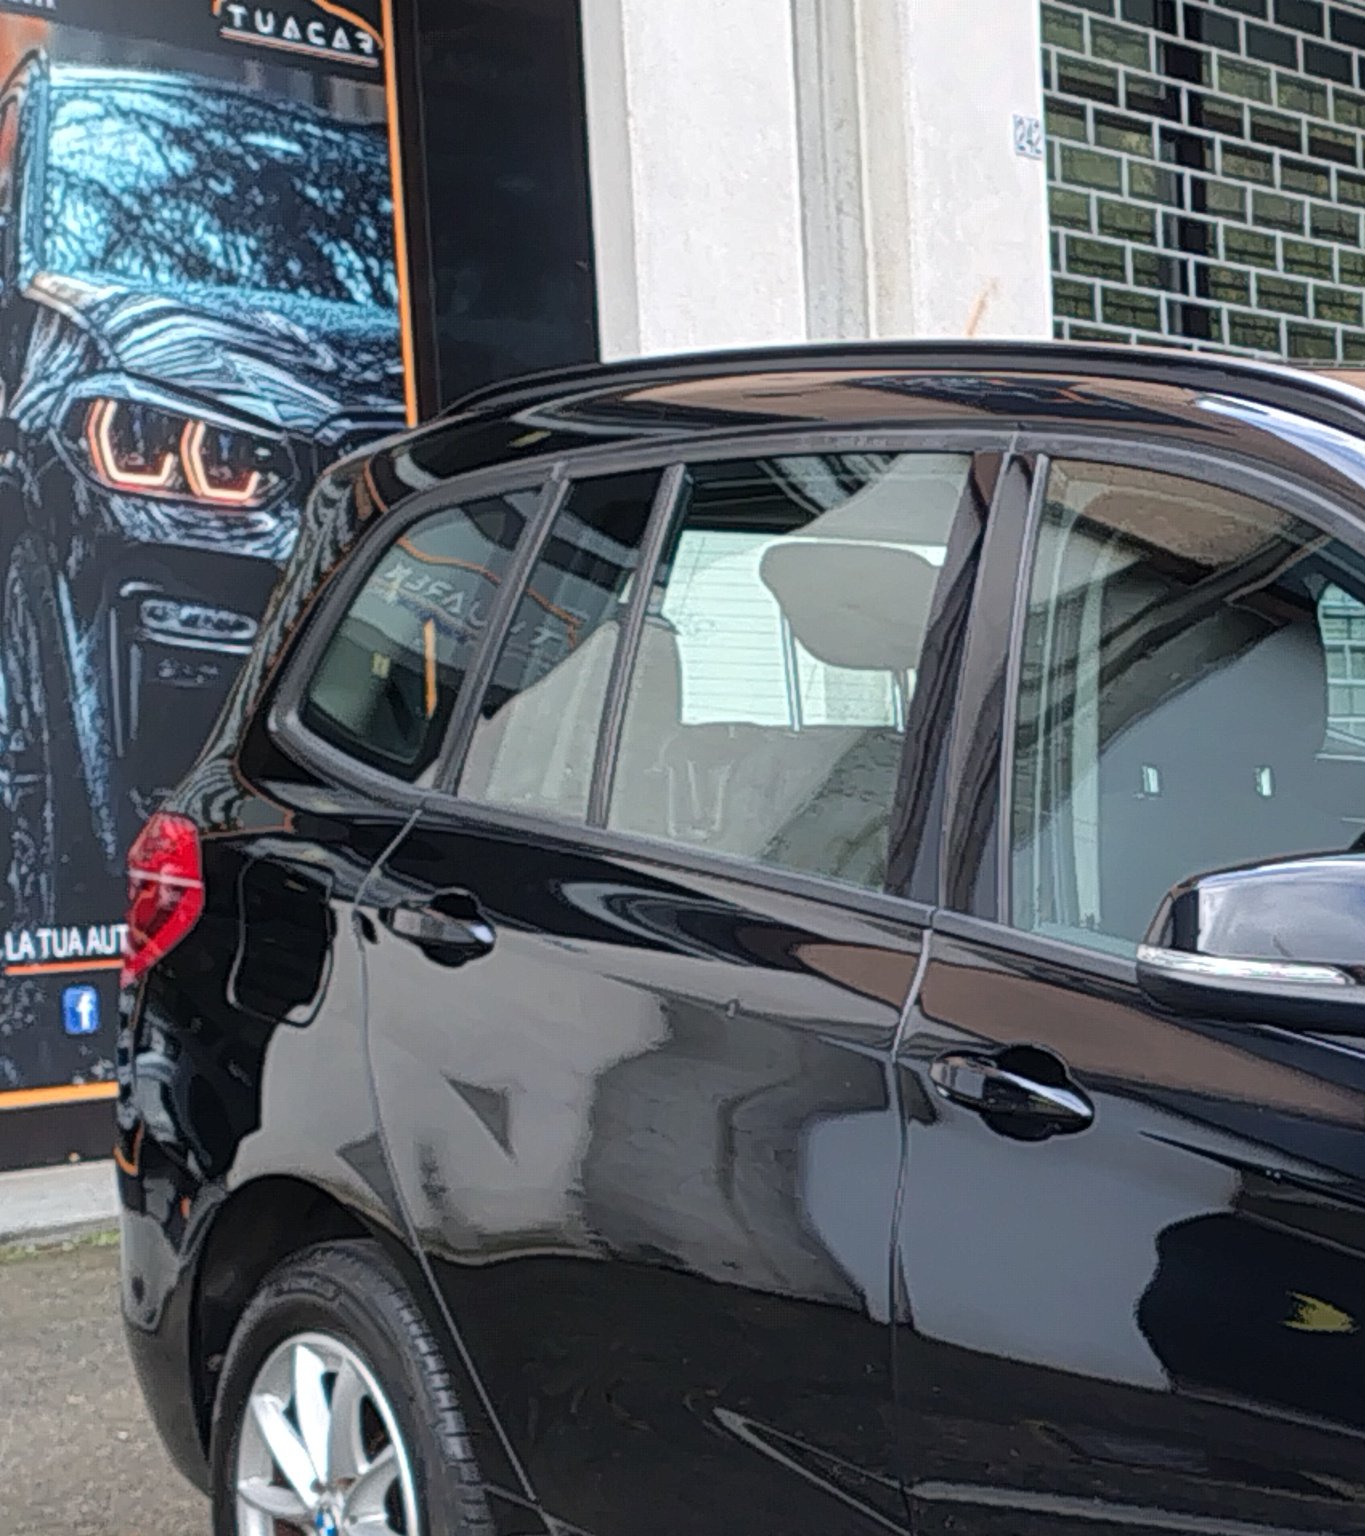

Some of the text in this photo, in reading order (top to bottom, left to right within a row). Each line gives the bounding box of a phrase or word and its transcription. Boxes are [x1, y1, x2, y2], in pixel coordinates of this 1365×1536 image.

[4, 923, 130, 961] LA TUA AUT
